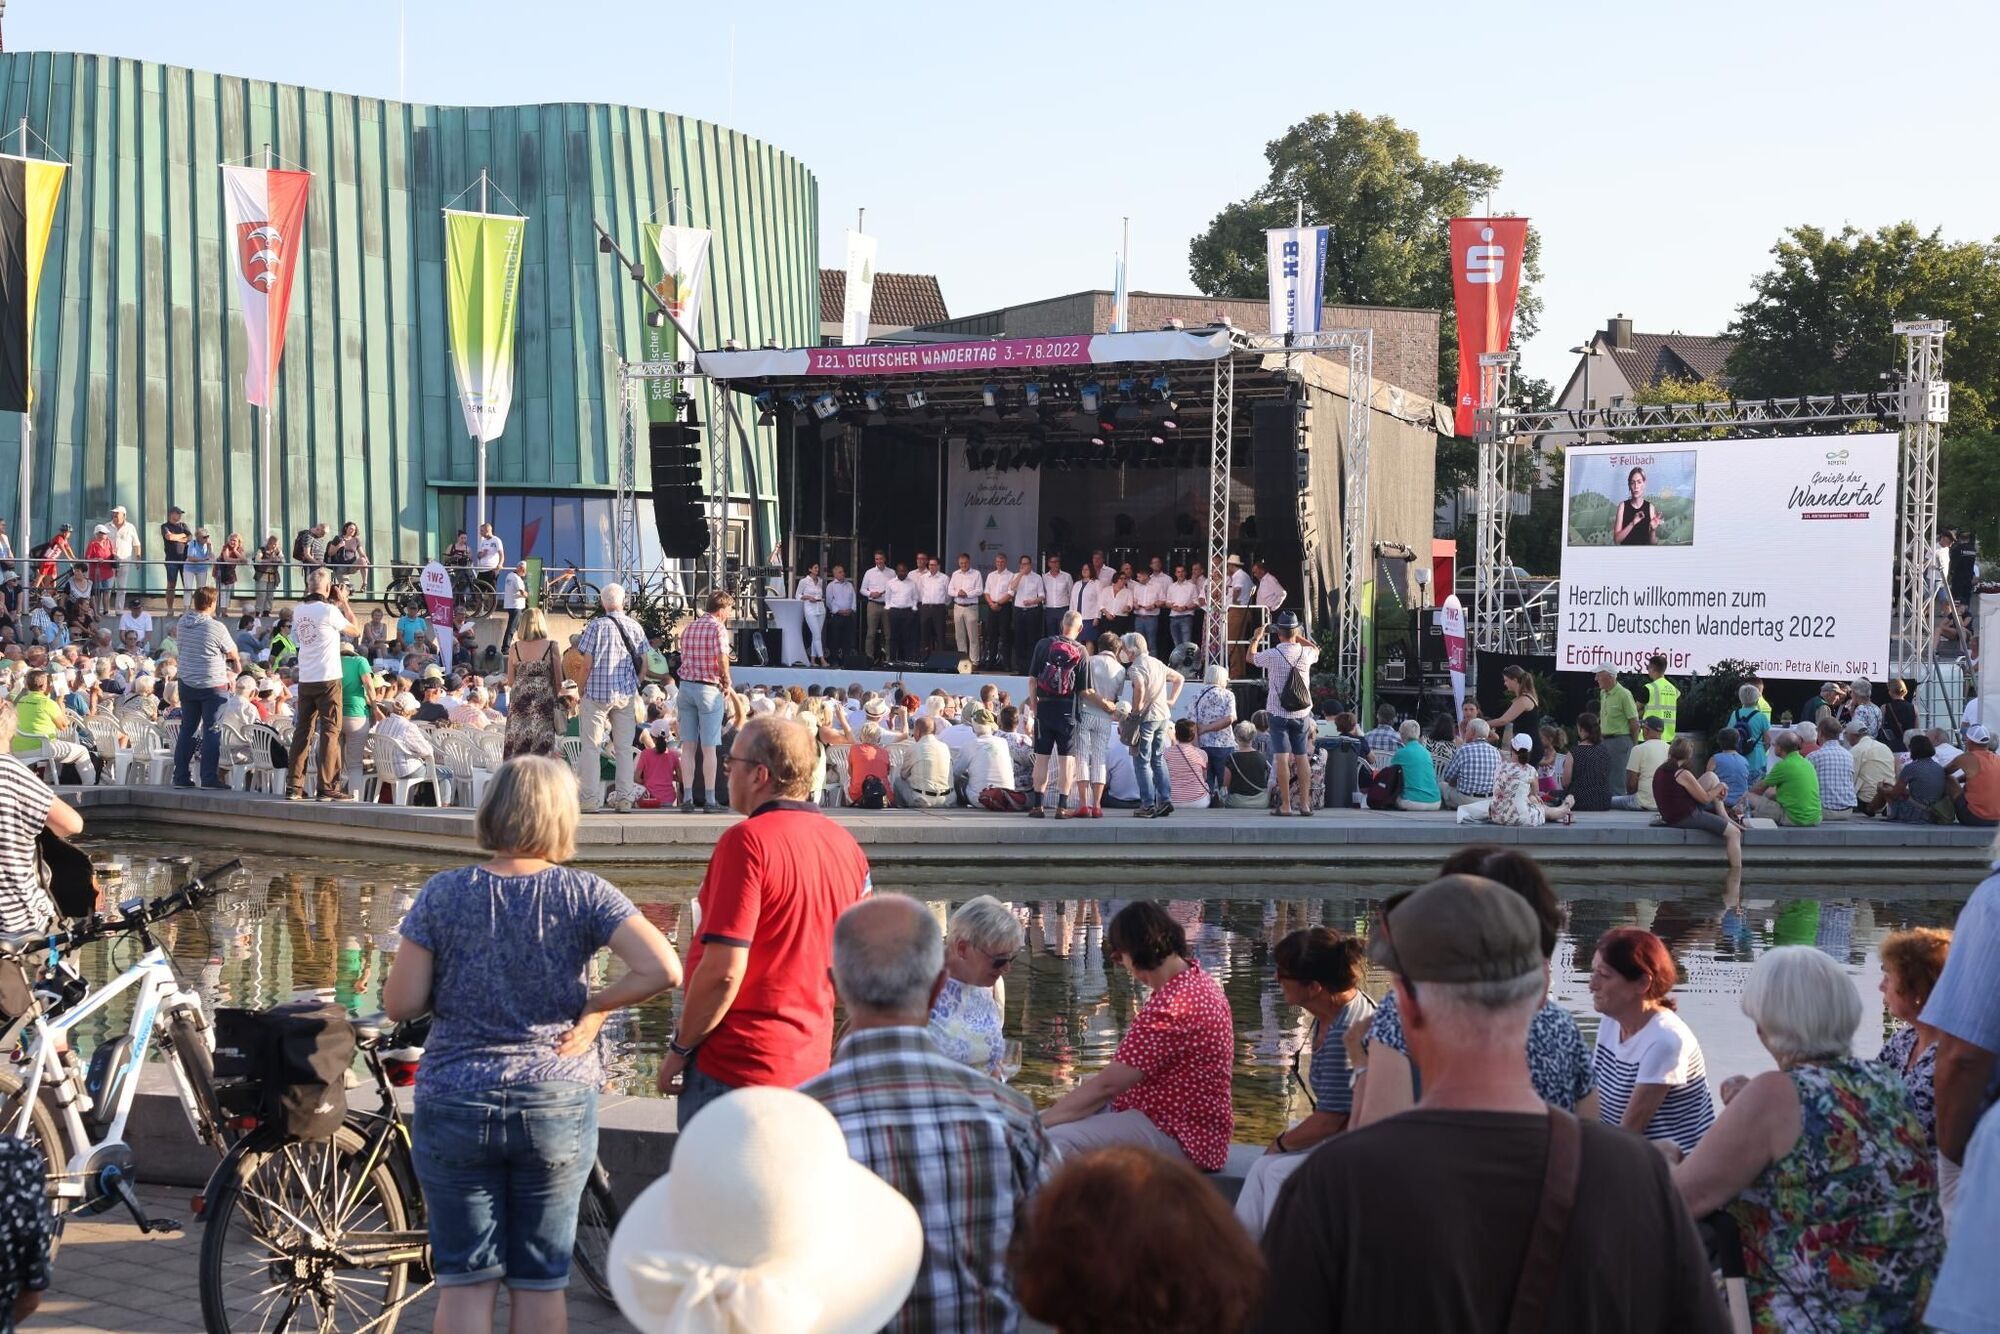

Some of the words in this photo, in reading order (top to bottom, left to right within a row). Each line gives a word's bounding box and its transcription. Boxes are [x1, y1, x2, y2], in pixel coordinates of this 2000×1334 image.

[817, 355, 845, 368] 121.
[848, 351, 918, 368] DEUTSCHER
[922, 347, 997, 365] WANDERTAG
[1620, 455, 1655, 466] Fellbach
[1812, 472, 1845, 486] Genieße
[1846, 471, 1862, 483] das
[1788, 482, 1886, 510] Wandertal
[1569, 585, 1629, 606] Herzlich
[1634, 586, 1727, 607] willkommen
[1731, 590, 1766, 608] zum
[1568, 612, 1601, 633] 121.
[1607, 613, 1690, 635] Deutschen
[1696, 614, 1785, 642] Wandertag
[1789, 615, 1836, 638] 2022
[1785, 660, 1811, 672] Petra
[1814, 660, 1842, 674] Klein,
[1846, 661, 1868, 674] SWR
[1871, 662, 1879, 675] 1
